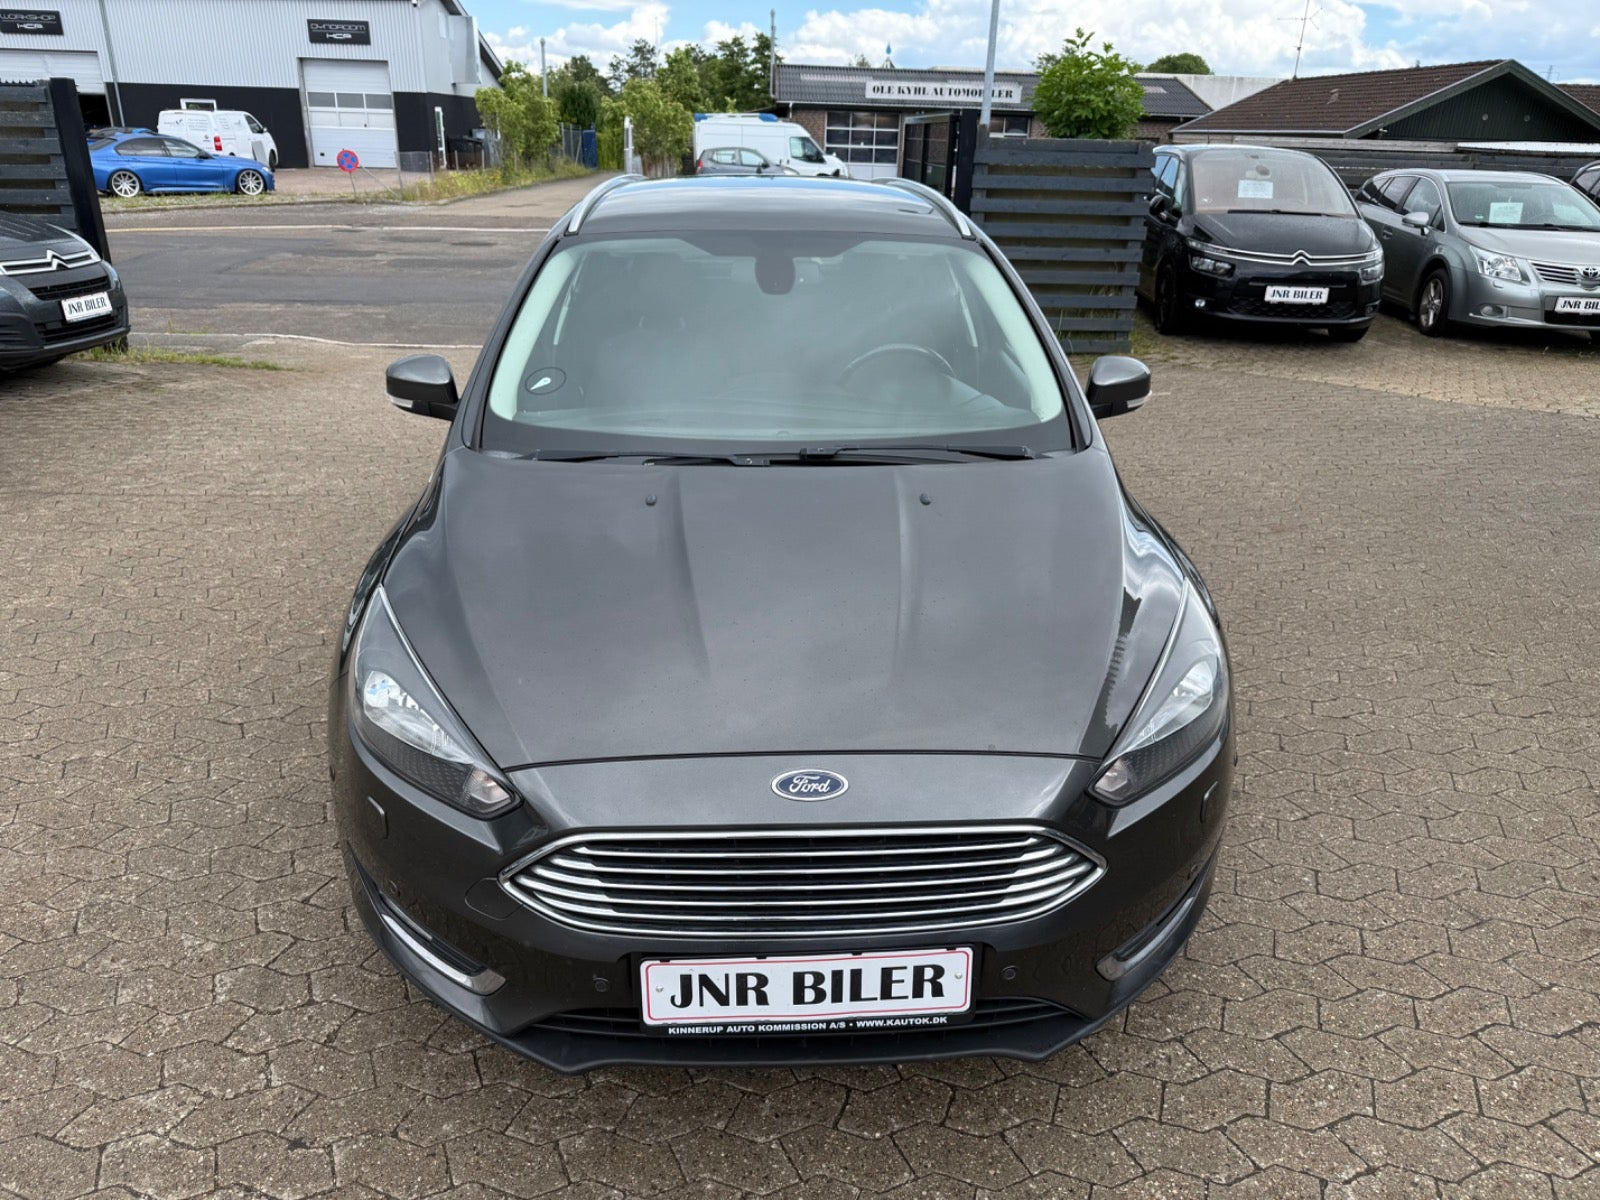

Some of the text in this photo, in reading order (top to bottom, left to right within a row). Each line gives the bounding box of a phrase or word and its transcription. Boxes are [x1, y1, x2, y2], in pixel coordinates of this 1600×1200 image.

[872, 85, 895, 95] OLE
[931, 87, 1013, 99] AUTOMOBLER
[1271, 289, 1323, 300] JNR BILER
[68, 296, 107, 315] JNR BILER
[1561, 300, 1582, 309] JNR
[789, 774, 831, 793] Ford
[670, 963, 945, 1009] JNR BILER
[668, 1016, 948, 1035] KINNERUP AUTO KOMMISSION A/S WWW.KAUTOK.DK
